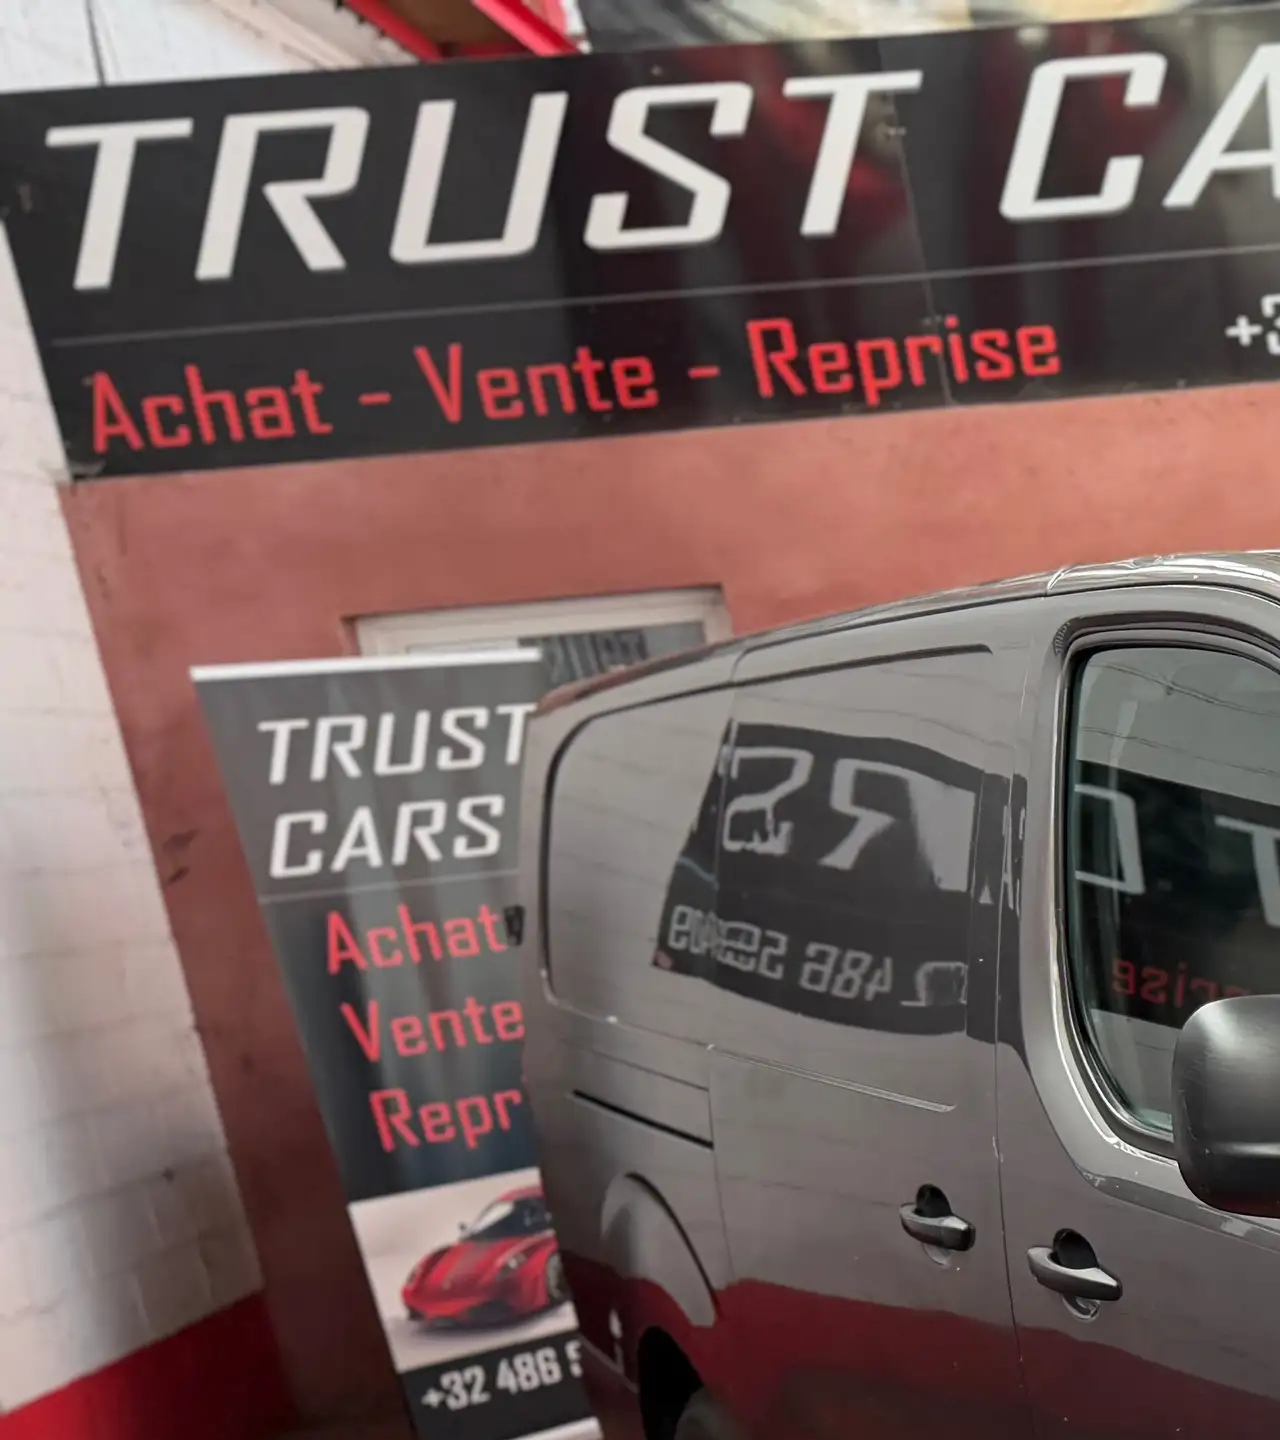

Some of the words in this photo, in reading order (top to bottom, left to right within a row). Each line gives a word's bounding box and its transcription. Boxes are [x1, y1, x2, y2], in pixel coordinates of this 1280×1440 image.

[44, 70, 924, 291] TRUST
[92, 364, 333, 454] Achat
[414, 343, 660, 424] Vente
[745, 317, 1063, 407] Reprise
[257, 703, 538, 785] TRUST
[269, 794, 505, 879] CARS
[327, 903, 506, 975] Achat
[341, 996, 526, 1063] Vente
[369, 1088, 522, 1153] Repr
[421, 1365, 491, 1411] +32
[496, 1346, 563, 1396] 486
